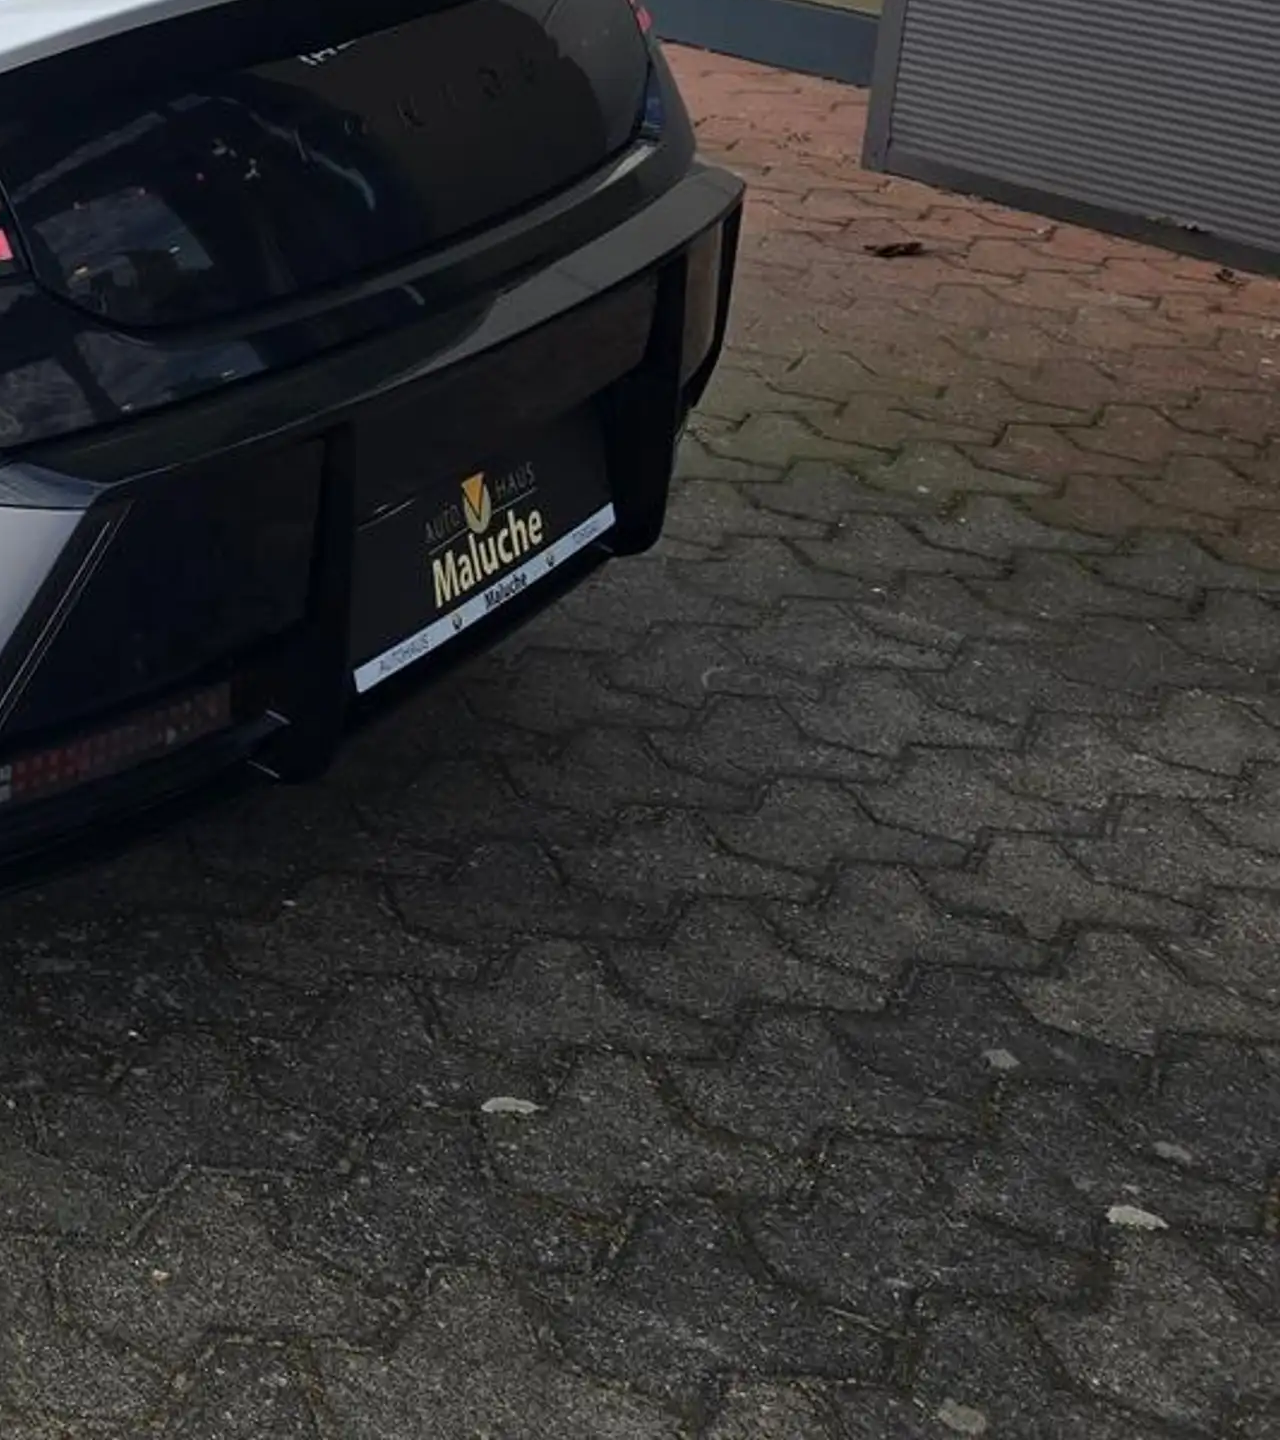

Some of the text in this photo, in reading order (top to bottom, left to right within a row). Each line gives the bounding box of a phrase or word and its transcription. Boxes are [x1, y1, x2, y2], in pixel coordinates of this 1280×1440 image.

[494, 460, 536, 500] HAUS
[432, 508, 544, 608] Maluche
[484, 573, 528, 609] Maluche
